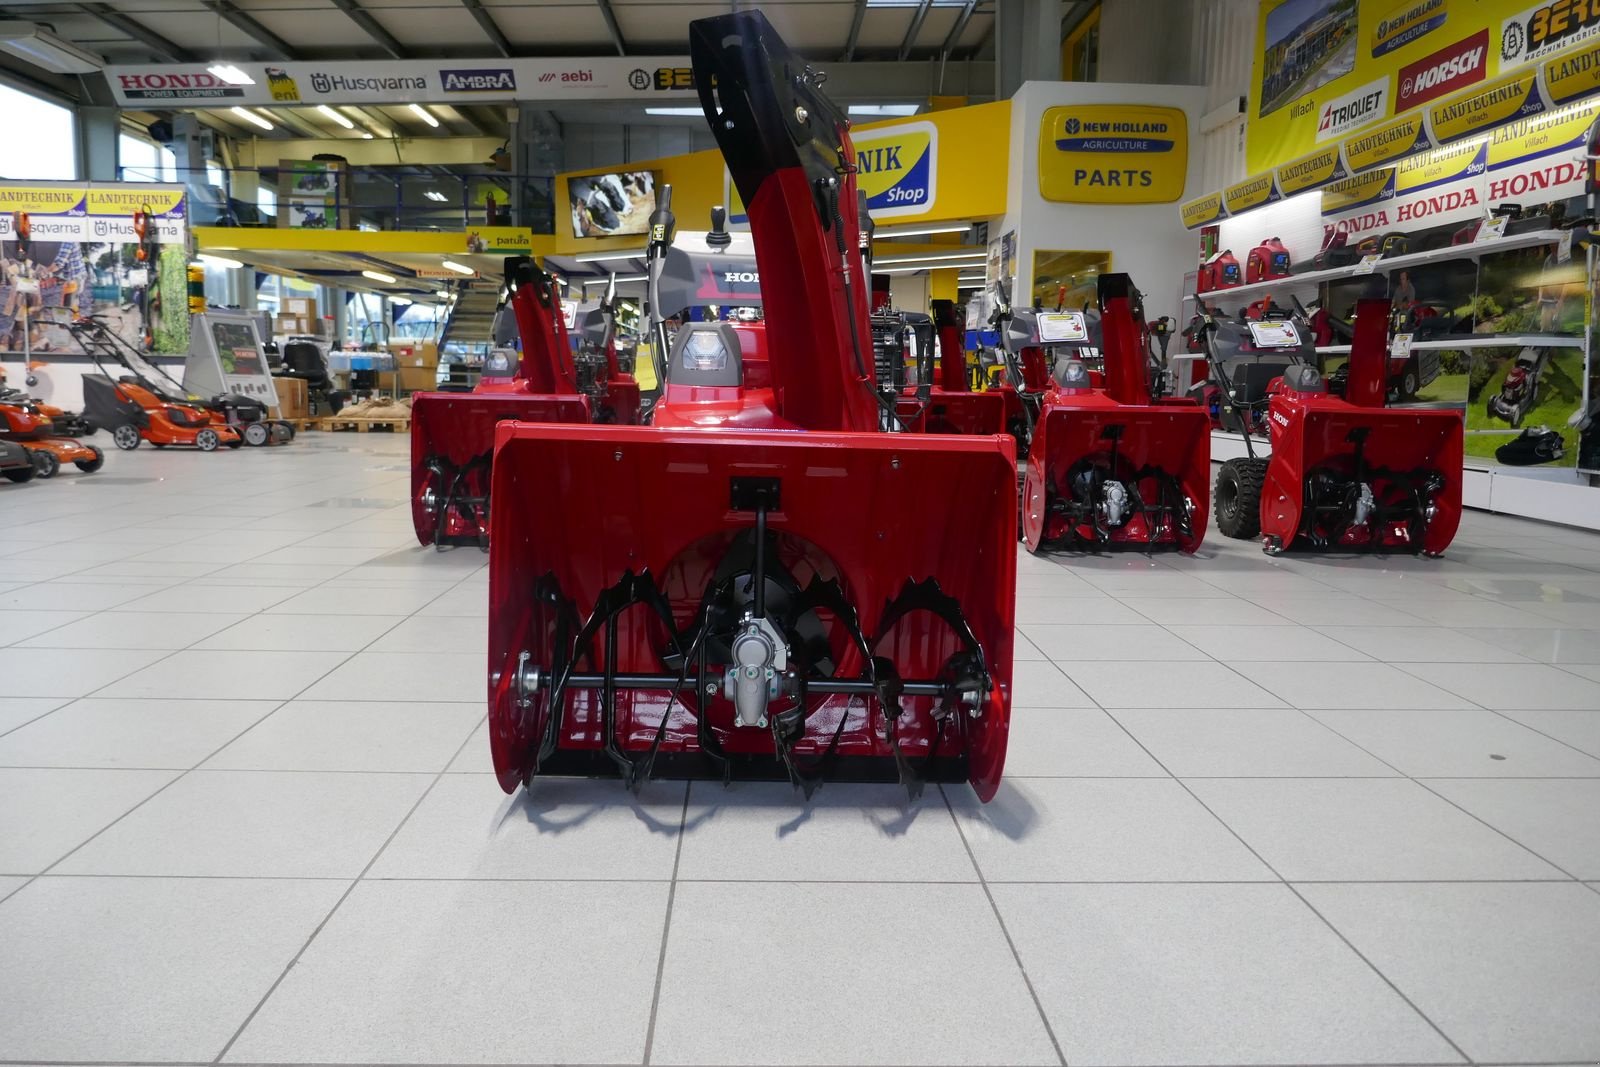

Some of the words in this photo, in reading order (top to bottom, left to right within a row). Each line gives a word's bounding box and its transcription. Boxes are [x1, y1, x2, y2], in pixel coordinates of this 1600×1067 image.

[1389, 14, 1406, 32] NEW
[1386, 22, 1428, 50] AGRICULTURE
[1524, 40, 1566, 61] MACCHINE
[561, 70, 593, 82] aebi
[1413, 46, 1483, 94] HORSCH
[332, 75, 426, 92] Husqvarna
[446, 73, 514, 89] AMBRA
[178, 89, 225, 98] EQUIPMENT
[274, 87, 298, 101] eni
[1290, 99, 1315, 120] Villach
[1332, 91, 1382, 127] TRIOLIET
[1434, 81, 1523, 126] LANDTECHNIK
[1521, 103, 1542, 114] Shop
[1083, 122, 1110, 133] NEW
[1113, 123, 1168, 133] HOLLAND
[1083, 141, 1148, 150] AGRICULTURE
[1349, 120, 1414, 157] LANDTECHNIK
[1413, 141, 1429, 151] Shop
[1524, 135, 1548, 149] Villach
[858, 146, 902, 174] NIK
[1280, 152, 1333, 182] LANDTECHNIK
[1424, 167, 1441, 178] Villach
[1466, 163, 1486, 175] Shop
[1074, 169, 1152, 187] PARTS
[0, 191, 74, 203] ANDTECHNIK
[887, 188, 924, 203] Shop
[1227, 178, 1270, 201] LANDTECHNIK
[1380, 189, 1394, 199] Shop
[91, 193, 172, 205] LANDTECHNIK
[1324, 211, 1389, 235] HONDA
[1397, 188, 1478, 222] HONDA
[109, 223, 178, 236] Husarna
[497, 236, 529, 247] patura
